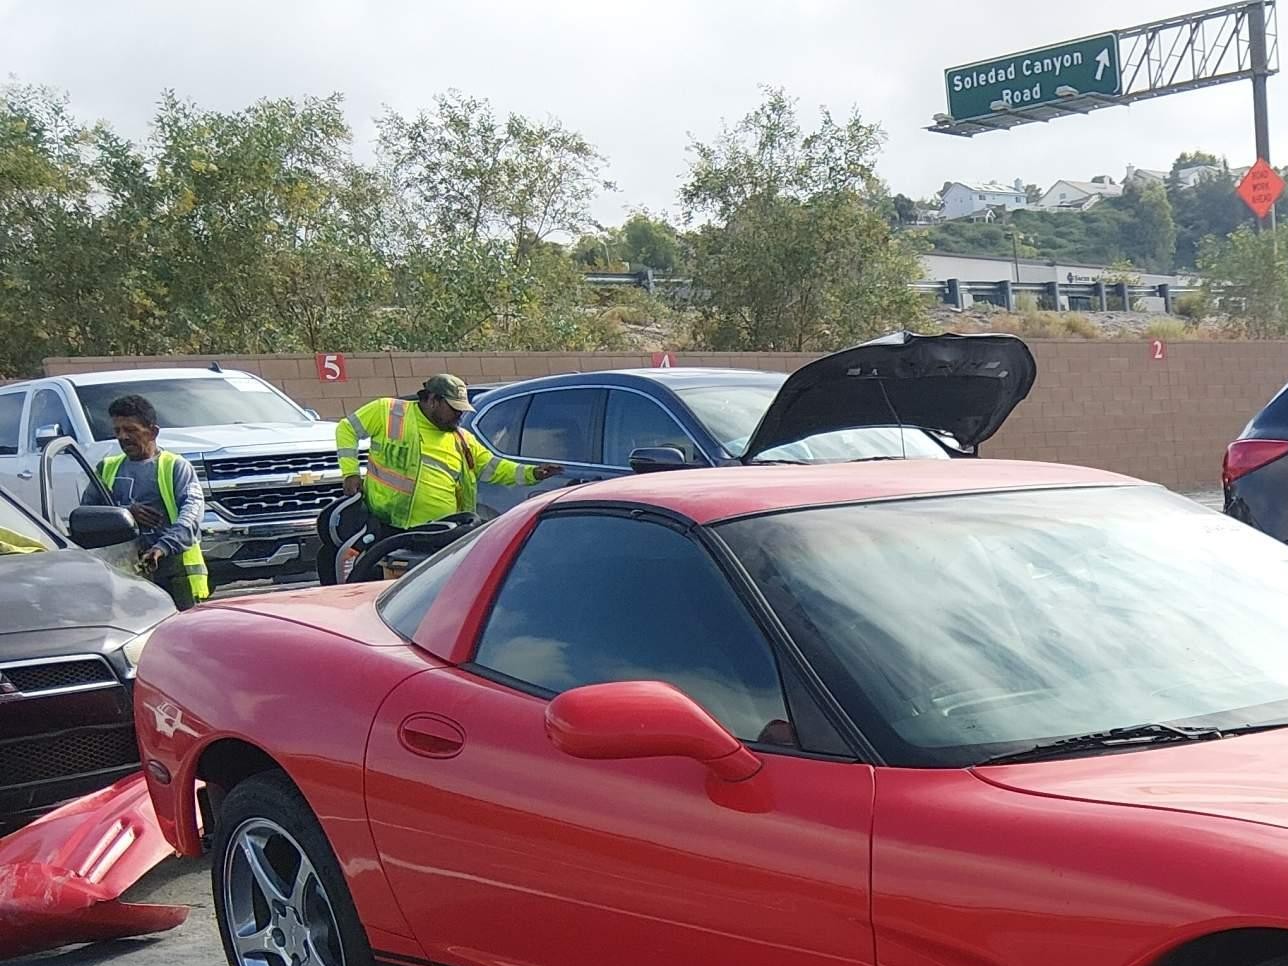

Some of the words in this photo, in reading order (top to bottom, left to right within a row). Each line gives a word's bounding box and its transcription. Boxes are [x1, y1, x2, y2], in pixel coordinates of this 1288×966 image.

[953, 63, 1015, 91] Soledad
[1022, 52, 1083, 76] Canyon
[1001, 83, 1041, 105] Road
[1153, 340, 1163, 359] 2
[324, 355, 340, 380] 5
